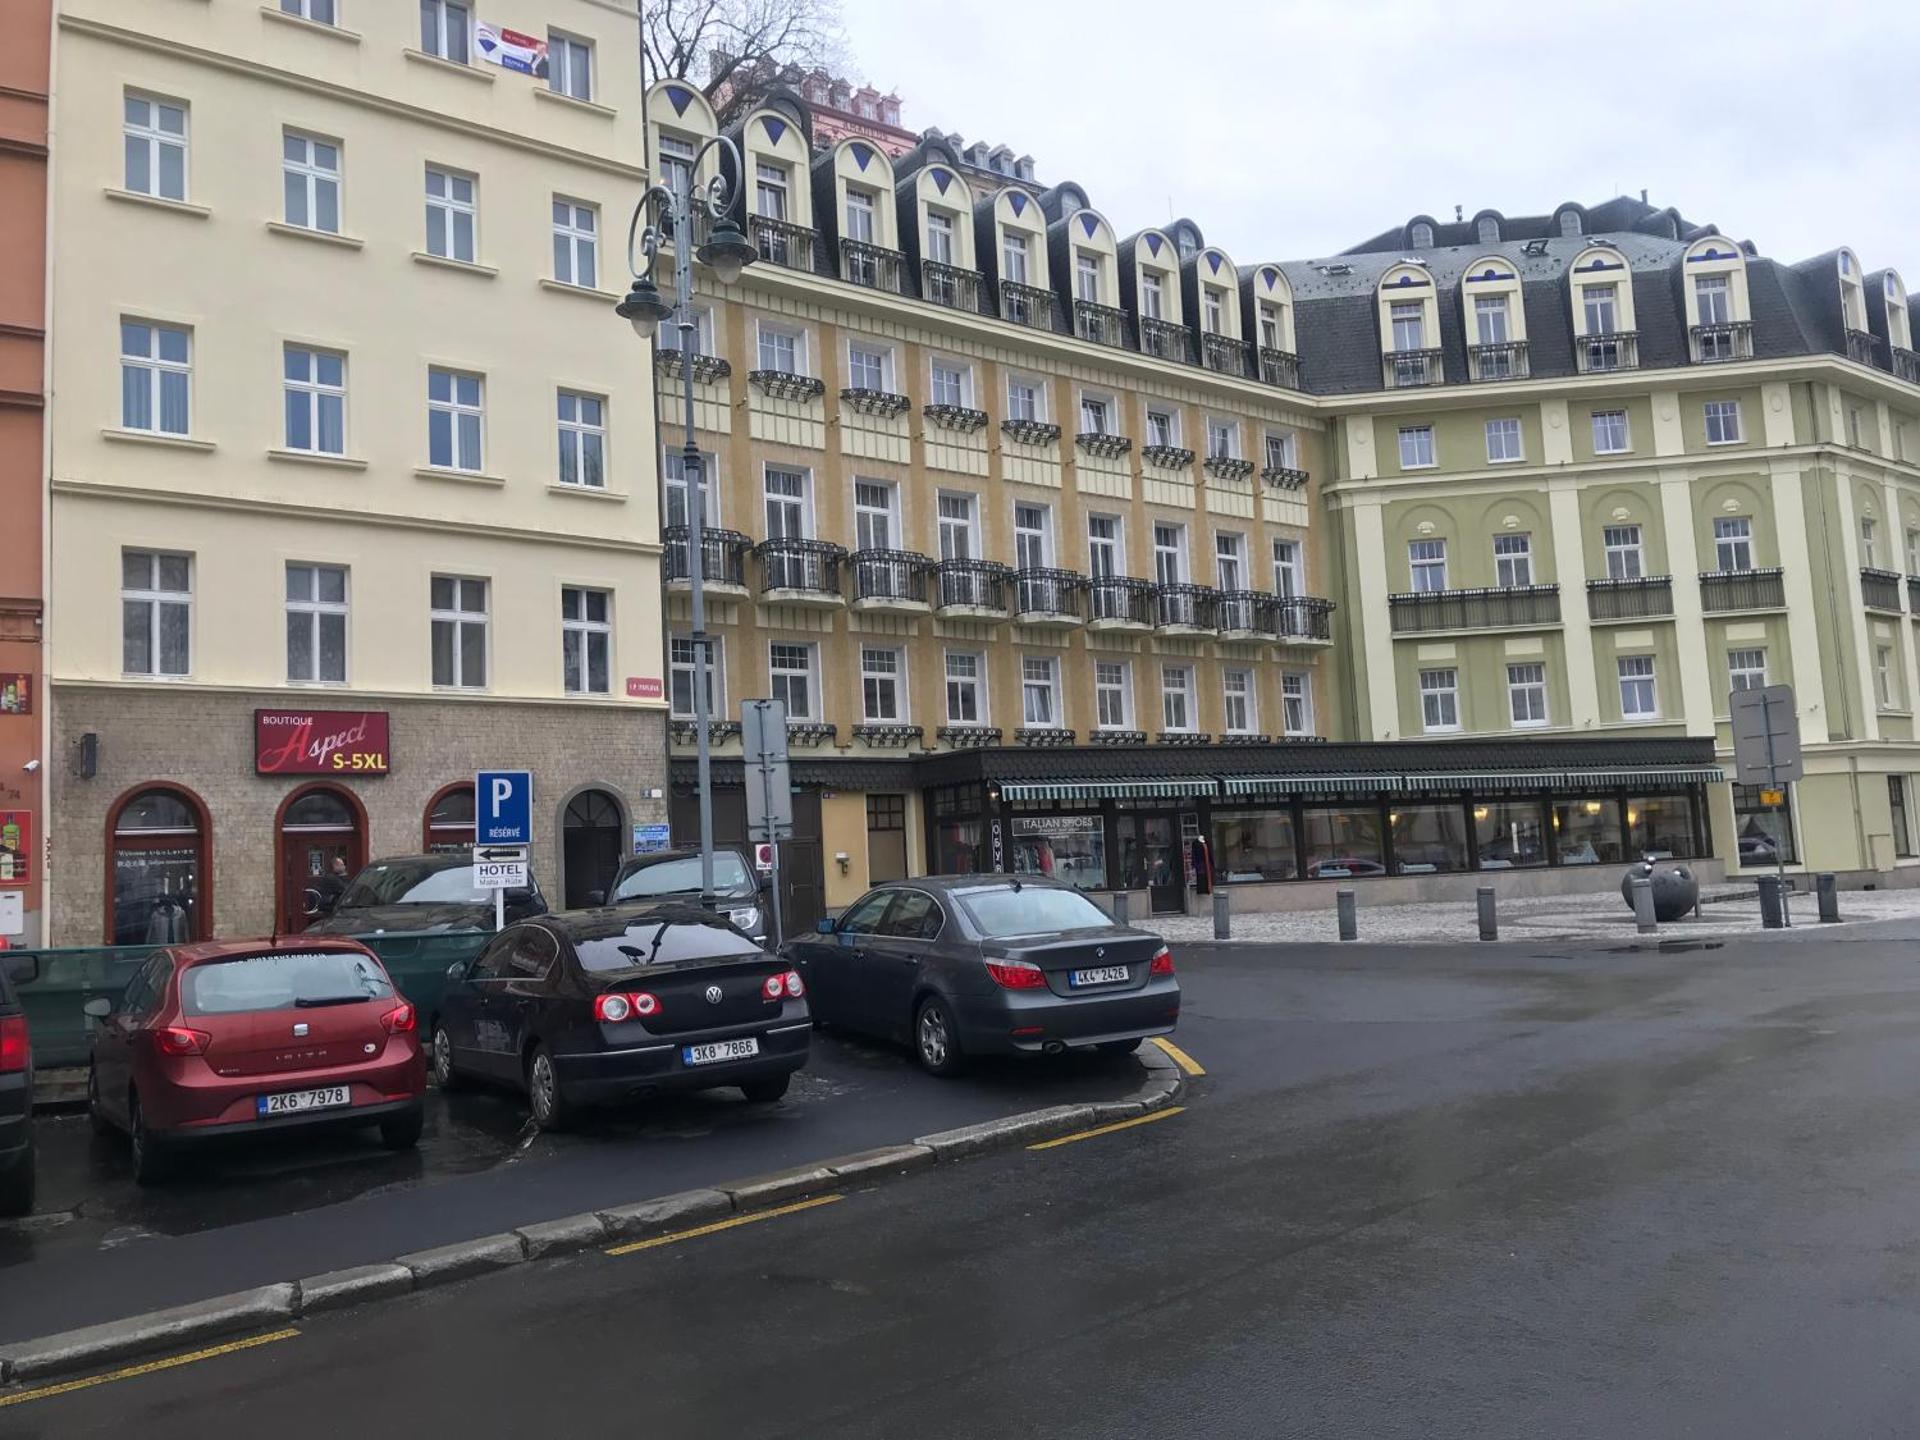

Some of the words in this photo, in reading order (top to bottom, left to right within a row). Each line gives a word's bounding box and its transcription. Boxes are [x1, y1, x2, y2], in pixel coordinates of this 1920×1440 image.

[263, 716, 313, 726] BOUTIQUE
[258, 713, 367, 772] Aspect
[333, 753, 387, 769] S-5XL
[492, 778, 513, 818] P
[1023, 820, 1060, 829] ITALIAN
[1062, 817, 1093, 828] SHOES
[480, 864, 522, 876] HOTEL
[270, 1094, 298, 1111] 2K6
[309, 1089, 343, 1105] 7978
